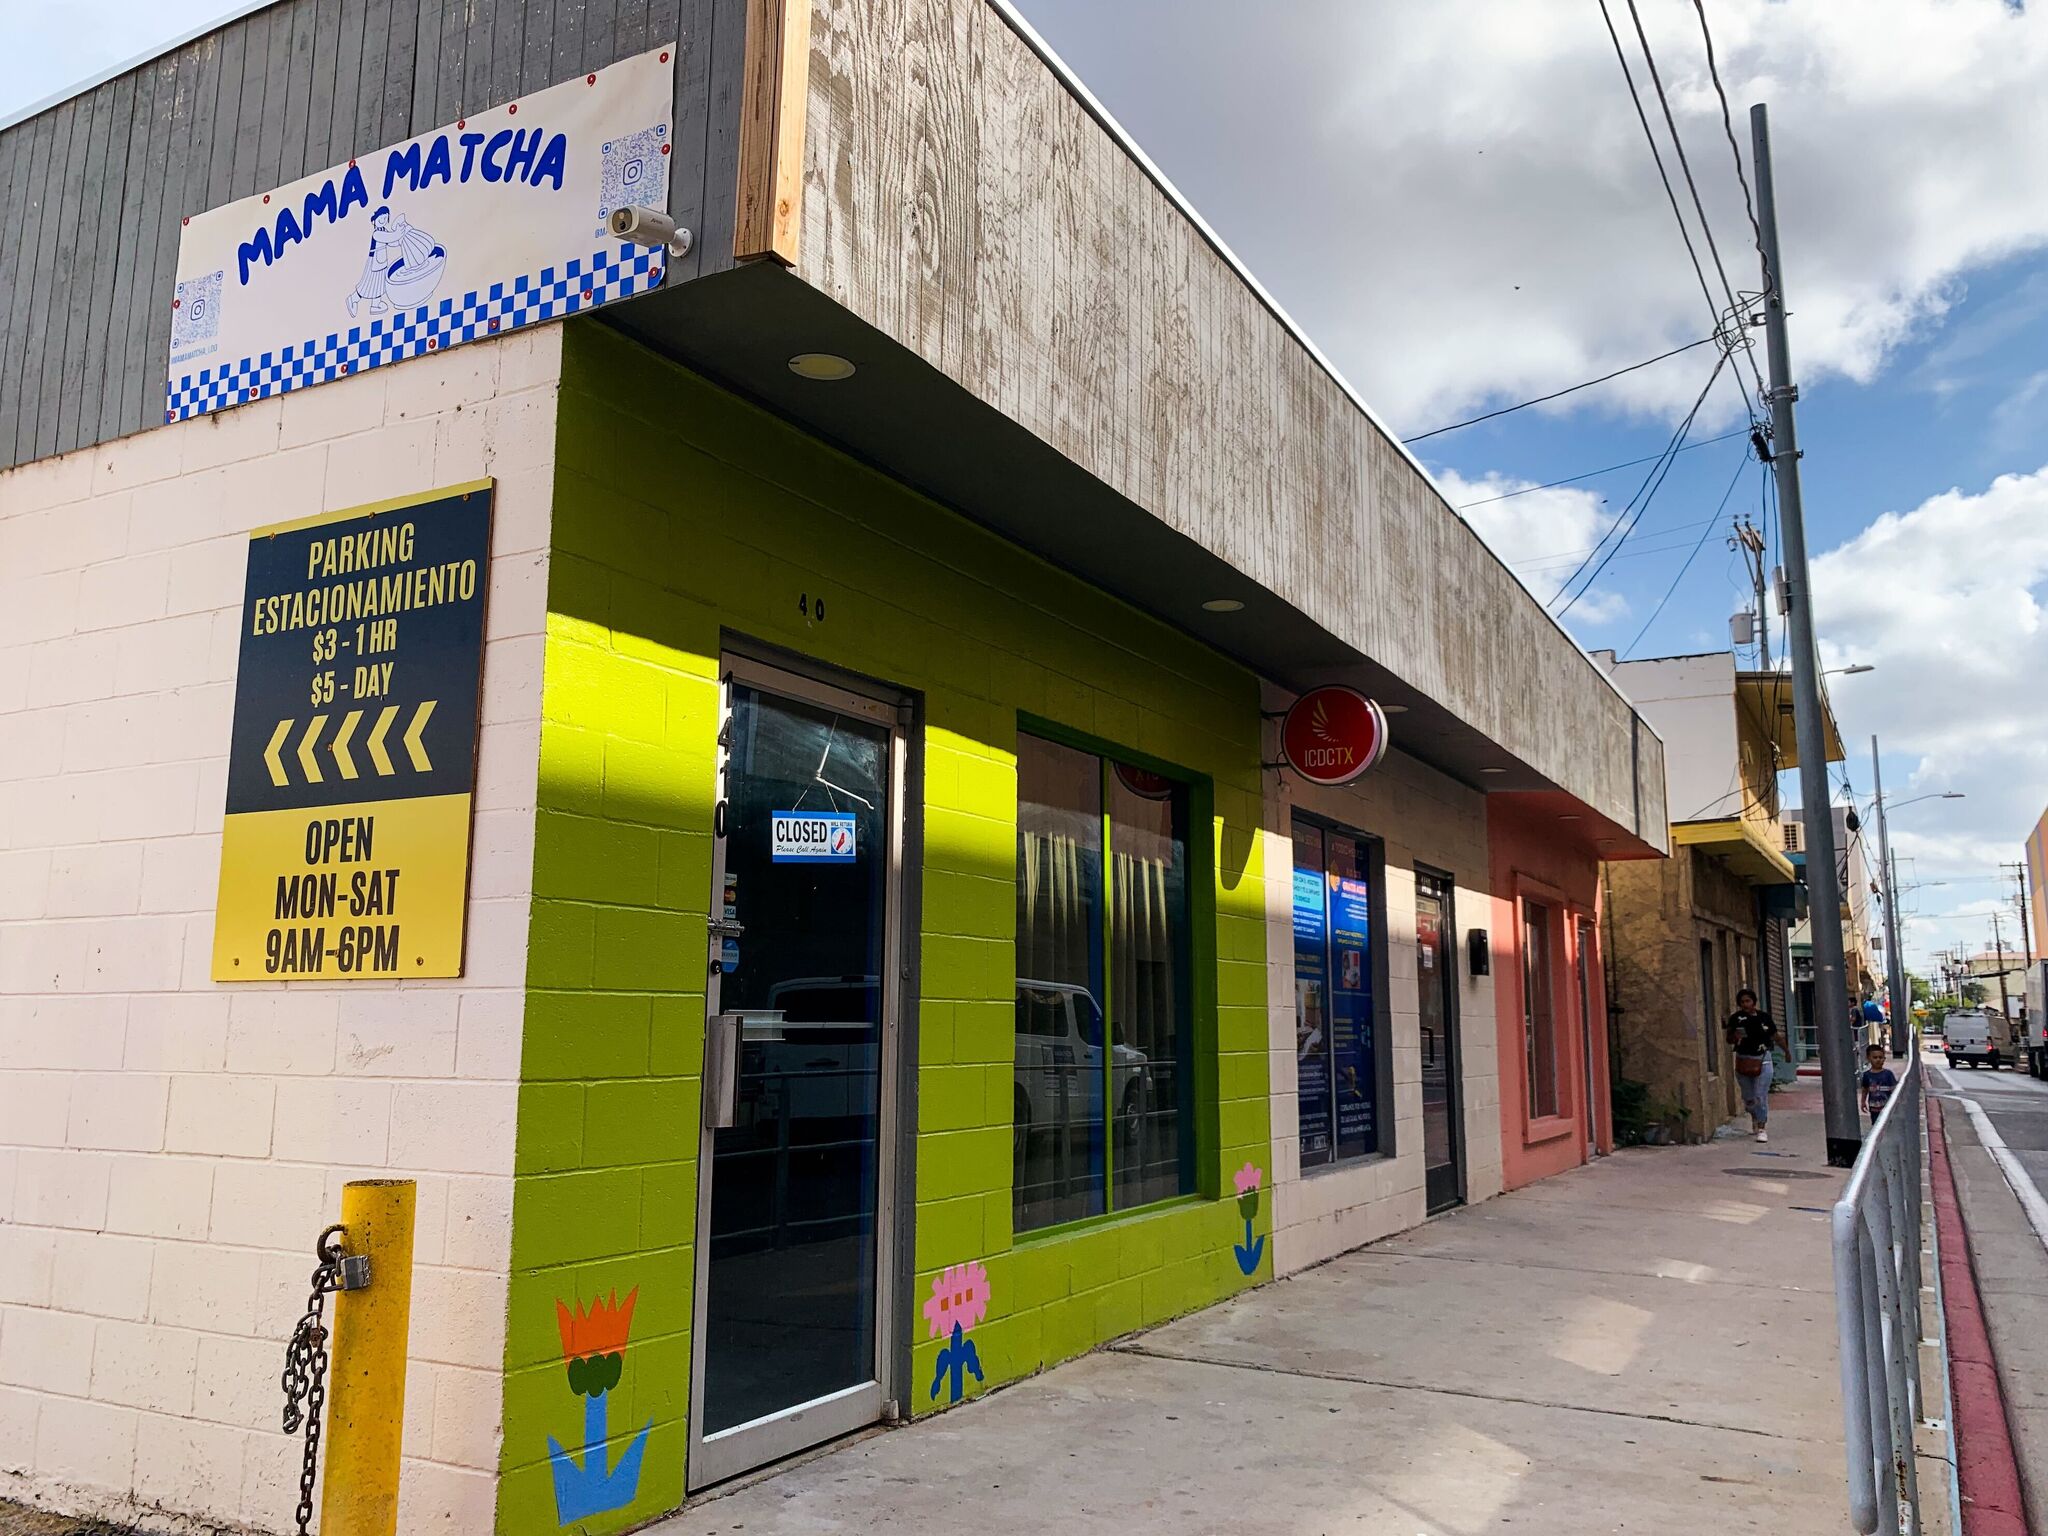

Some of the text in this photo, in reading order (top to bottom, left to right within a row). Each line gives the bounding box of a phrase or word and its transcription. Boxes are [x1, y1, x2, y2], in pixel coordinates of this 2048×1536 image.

[237, 127, 568, 286] MAMA MATCHA
[307, 522, 415, 580] PARKING
[252, 559, 477, 636] ESTACIONAMIENTO
[312, 628, 338, 666] $3
[311, 670, 335, 708] $5
[353, 661, 394, 700] DAY
[1304, 746, 1354, 768] ICDCTX
[305, 816, 374, 866] OPEN
[776, 819, 828, 843] CLOSED
[776, 844, 827, 855] Please Call Again
[275, 869, 400, 920] MON-SAT
[265, 924, 400, 974] 9AM-6PM
